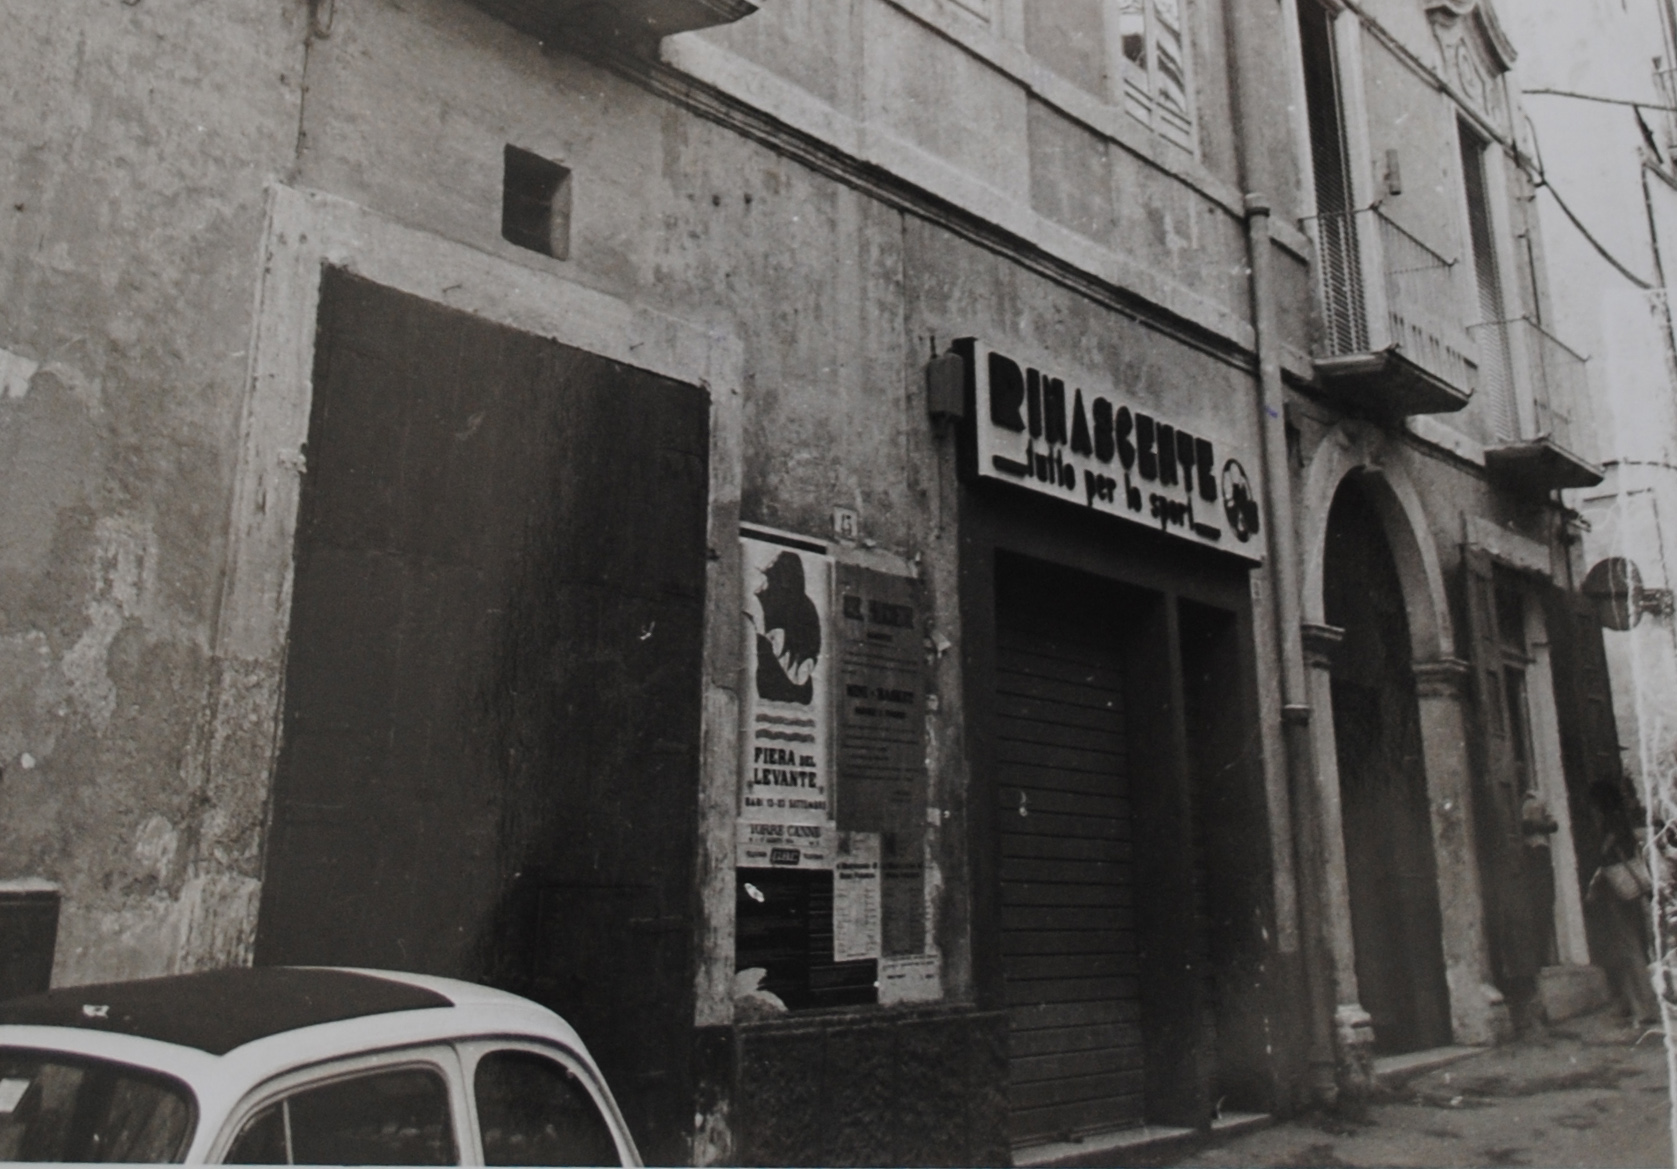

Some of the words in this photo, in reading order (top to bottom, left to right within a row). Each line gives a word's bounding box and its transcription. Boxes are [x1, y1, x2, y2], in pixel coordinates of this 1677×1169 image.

[988, 351, 1217, 503] RINASCENTE
[1084, 469, 1117, 507] per
[1149, 492, 1195, 533] sport
[753, 768, 817, 788] LEVANTE
[754, 747, 797, 766] FIERA
[799, 755, 817, 768] DEL
